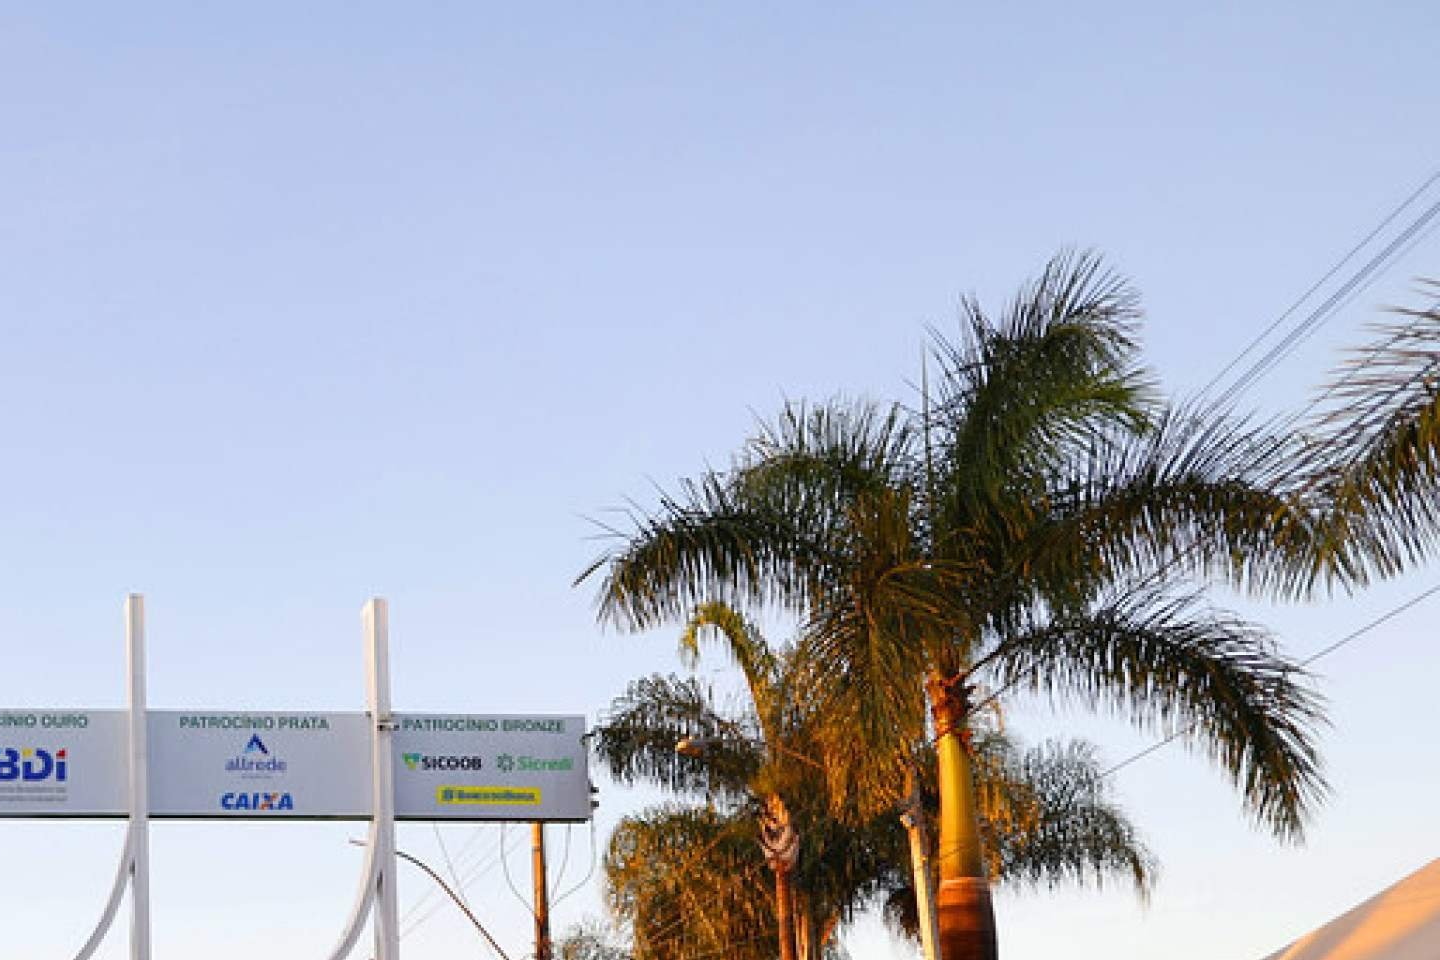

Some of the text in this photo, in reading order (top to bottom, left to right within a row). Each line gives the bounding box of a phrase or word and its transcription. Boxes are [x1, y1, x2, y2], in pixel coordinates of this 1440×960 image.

[41, 714, 88, 729] OURO
[179, 714, 330, 730] PATROCÍNIO PRATA
[402, 717, 566, 733] PATROCÍNIO BRONZE
[421, 756, 482, 771] SICOOB
[516, 755, 574, 771] Sicredi
[220, 791, 295, 811] CAIXA
